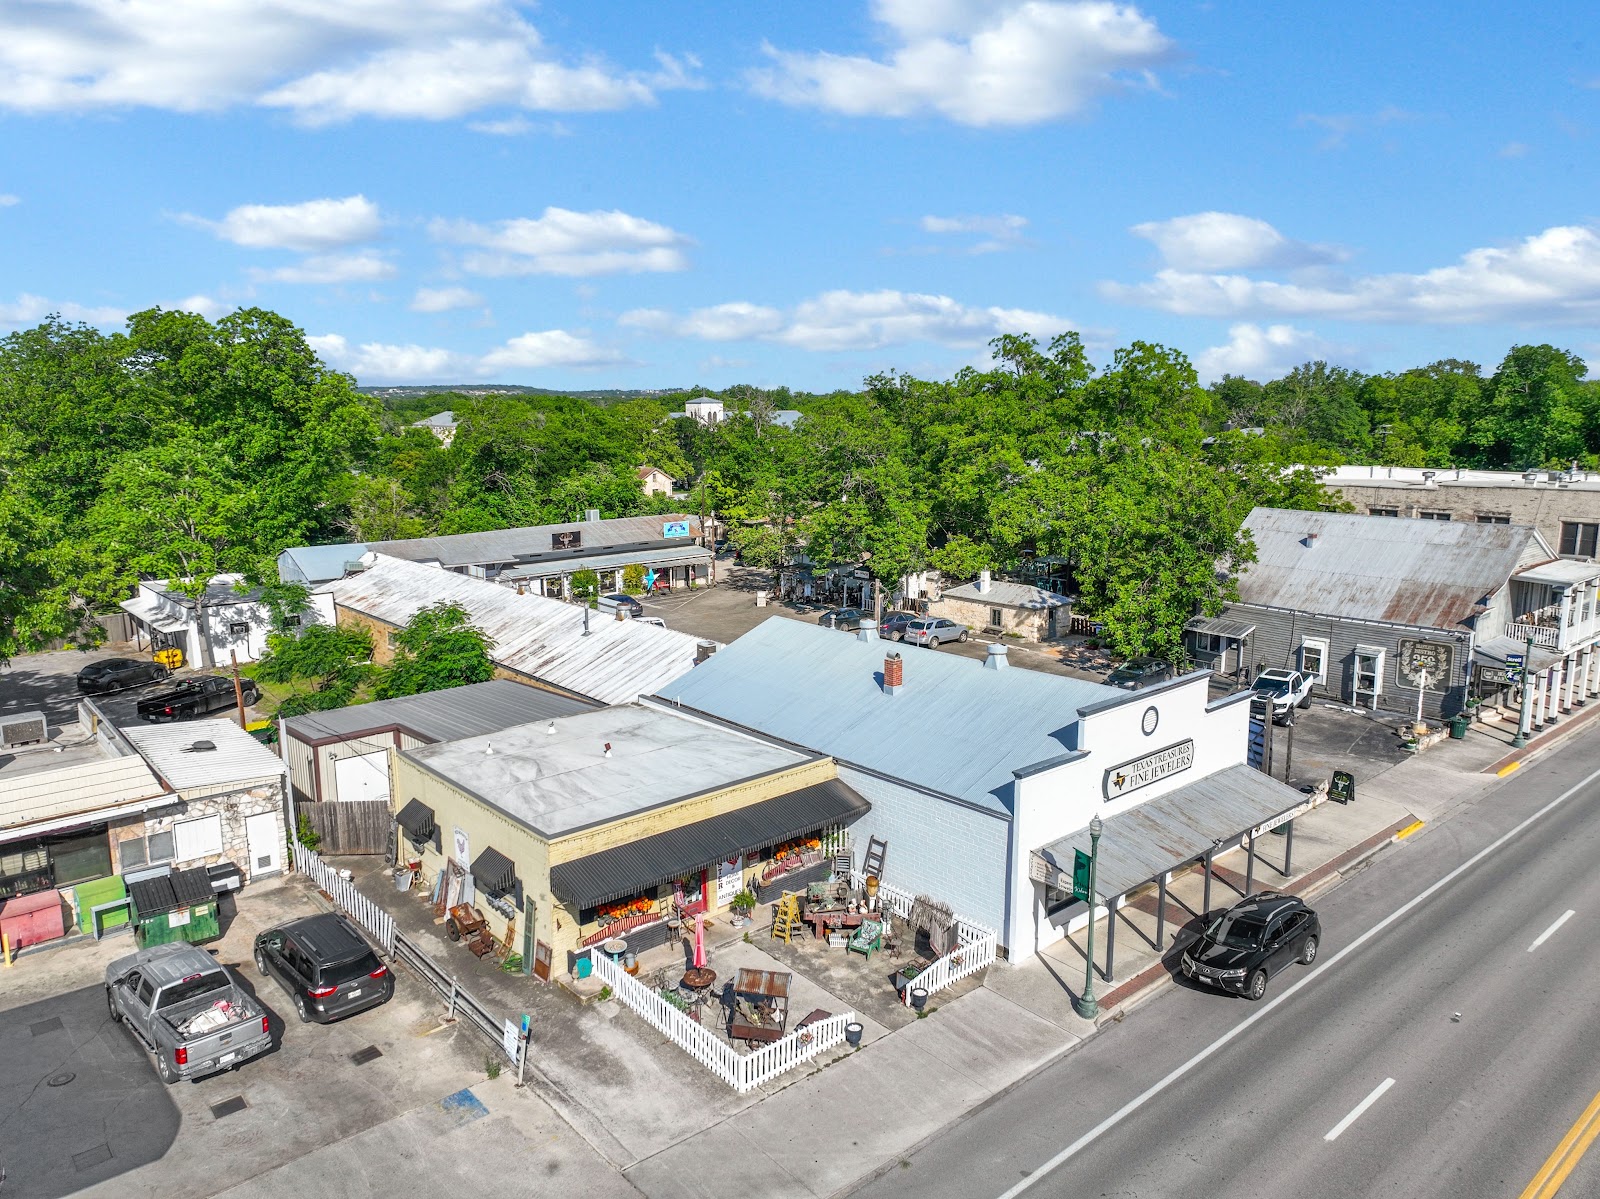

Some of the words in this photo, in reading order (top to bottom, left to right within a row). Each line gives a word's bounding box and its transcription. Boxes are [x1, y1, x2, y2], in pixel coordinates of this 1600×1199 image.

[1132, 758, 1153, 773] TEXAS
[1154, 744, 1190, 763] TREASURES
[1130, 770, 1150, 787] FINE
[1150, 754, 1191, 780] JEWELERS
[725, 877, 741, 886] DECOR
[718, 888, 742, 900] ANTIQUES
